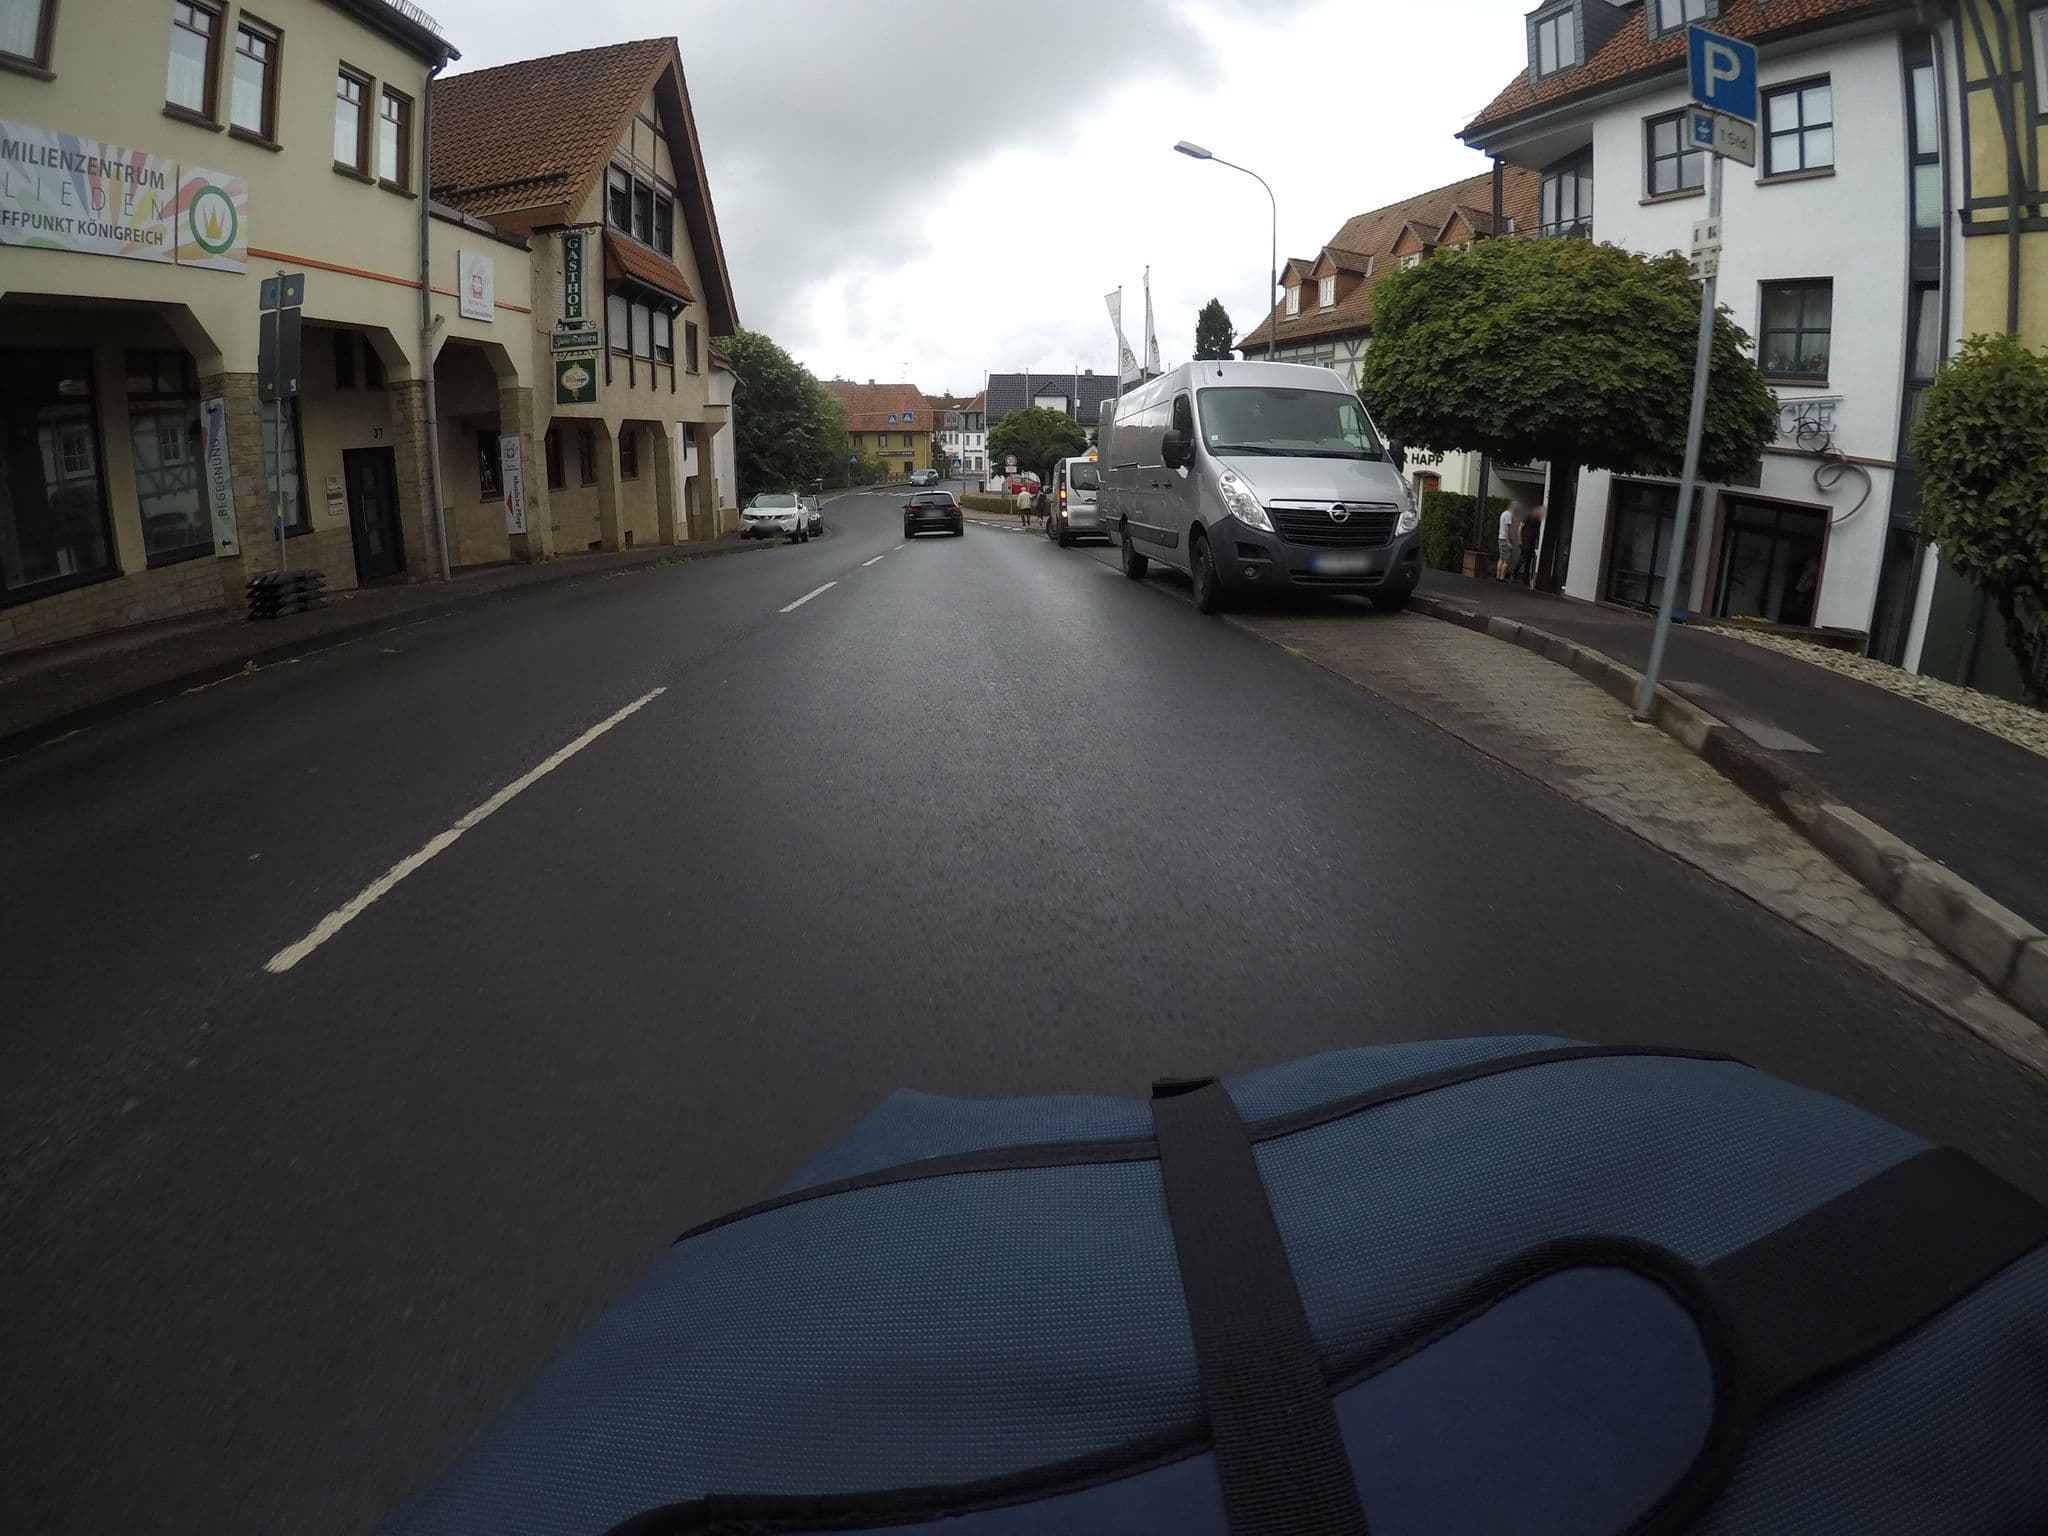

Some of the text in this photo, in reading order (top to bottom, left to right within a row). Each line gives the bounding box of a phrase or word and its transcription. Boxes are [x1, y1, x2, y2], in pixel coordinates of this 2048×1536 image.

[1703, 40, 1741, 98] P
[5, 171, 164, 221] LIEDEN
[0, 208, 164, 246] FFPUNKT KÖNIGREICH
[566, 238, 580, 317] GASTHOF
[372, 427, 383, 440] 37
[210, 438, 228, 517] BEGEGNUNG
[1411, 452, 1444, 467] HAPP
